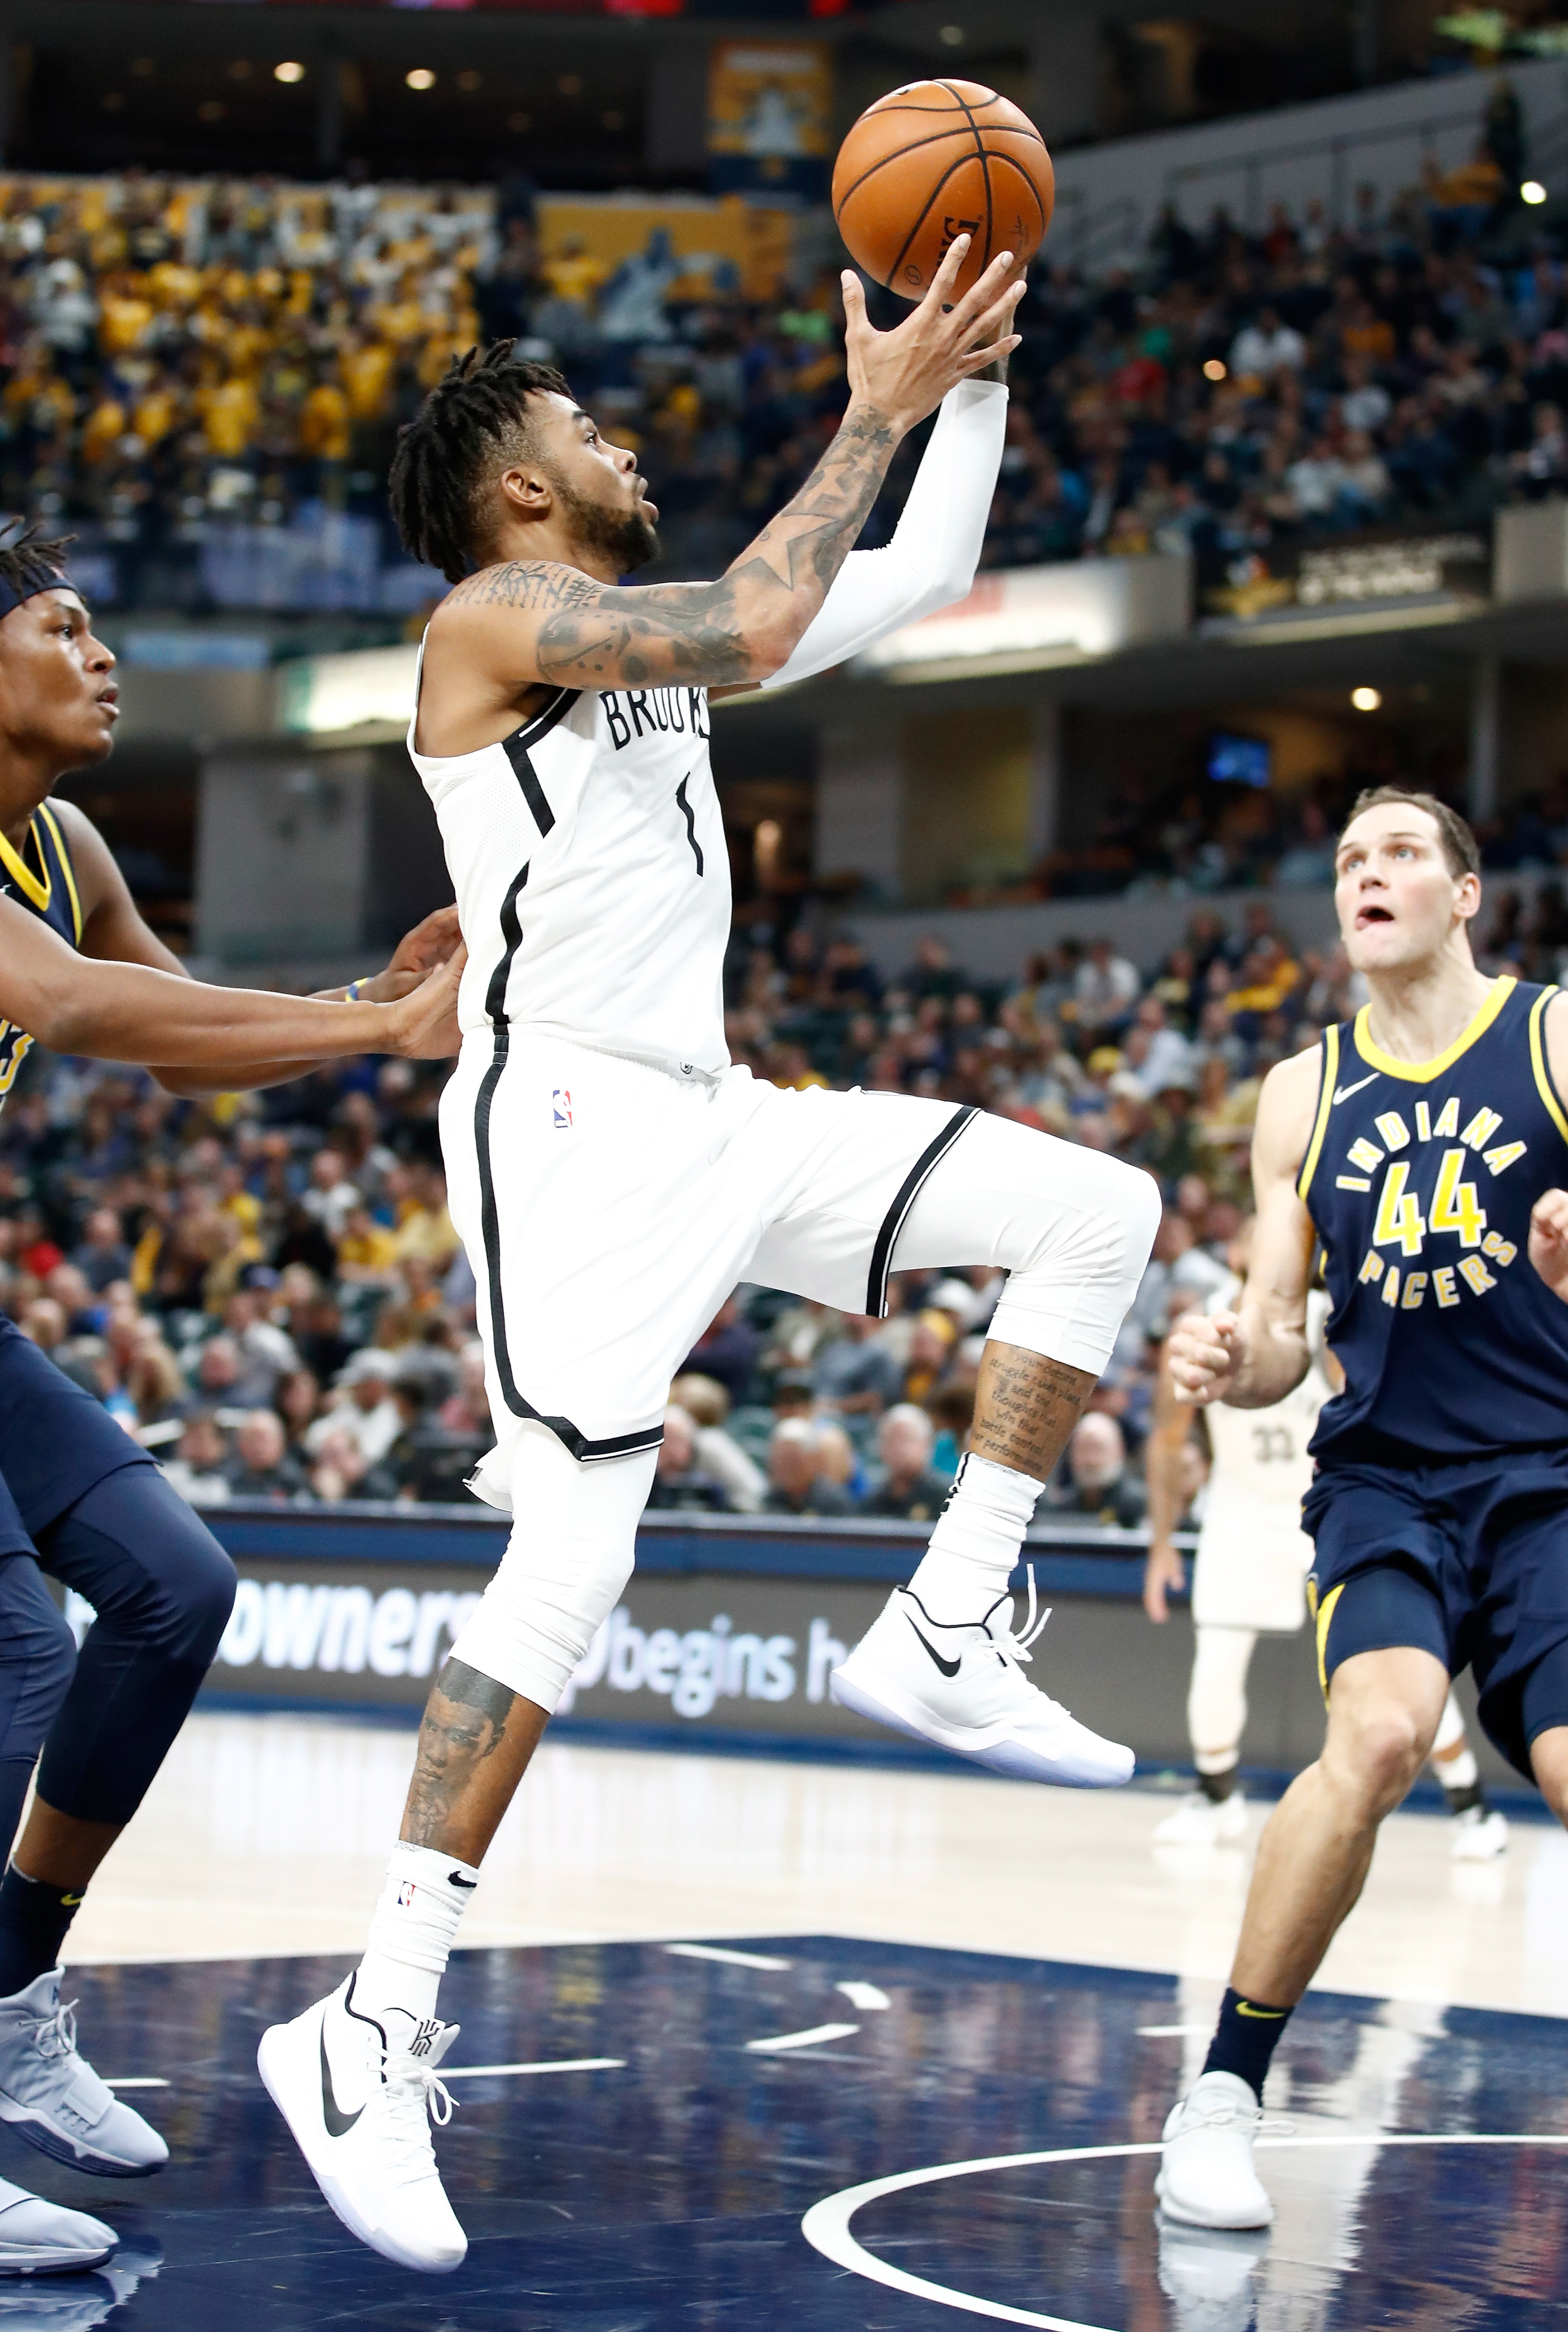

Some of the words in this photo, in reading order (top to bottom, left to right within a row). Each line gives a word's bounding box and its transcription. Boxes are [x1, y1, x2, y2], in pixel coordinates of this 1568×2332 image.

[675, 771, 704, 877] 1
[1336, 1097, 1527, 1193] INDIANA
[1372, 1147, 1487, 1257] 44
[1357, 1230, 1518, 1310] PACERS
[607, 1604, 797, 1719] begins
